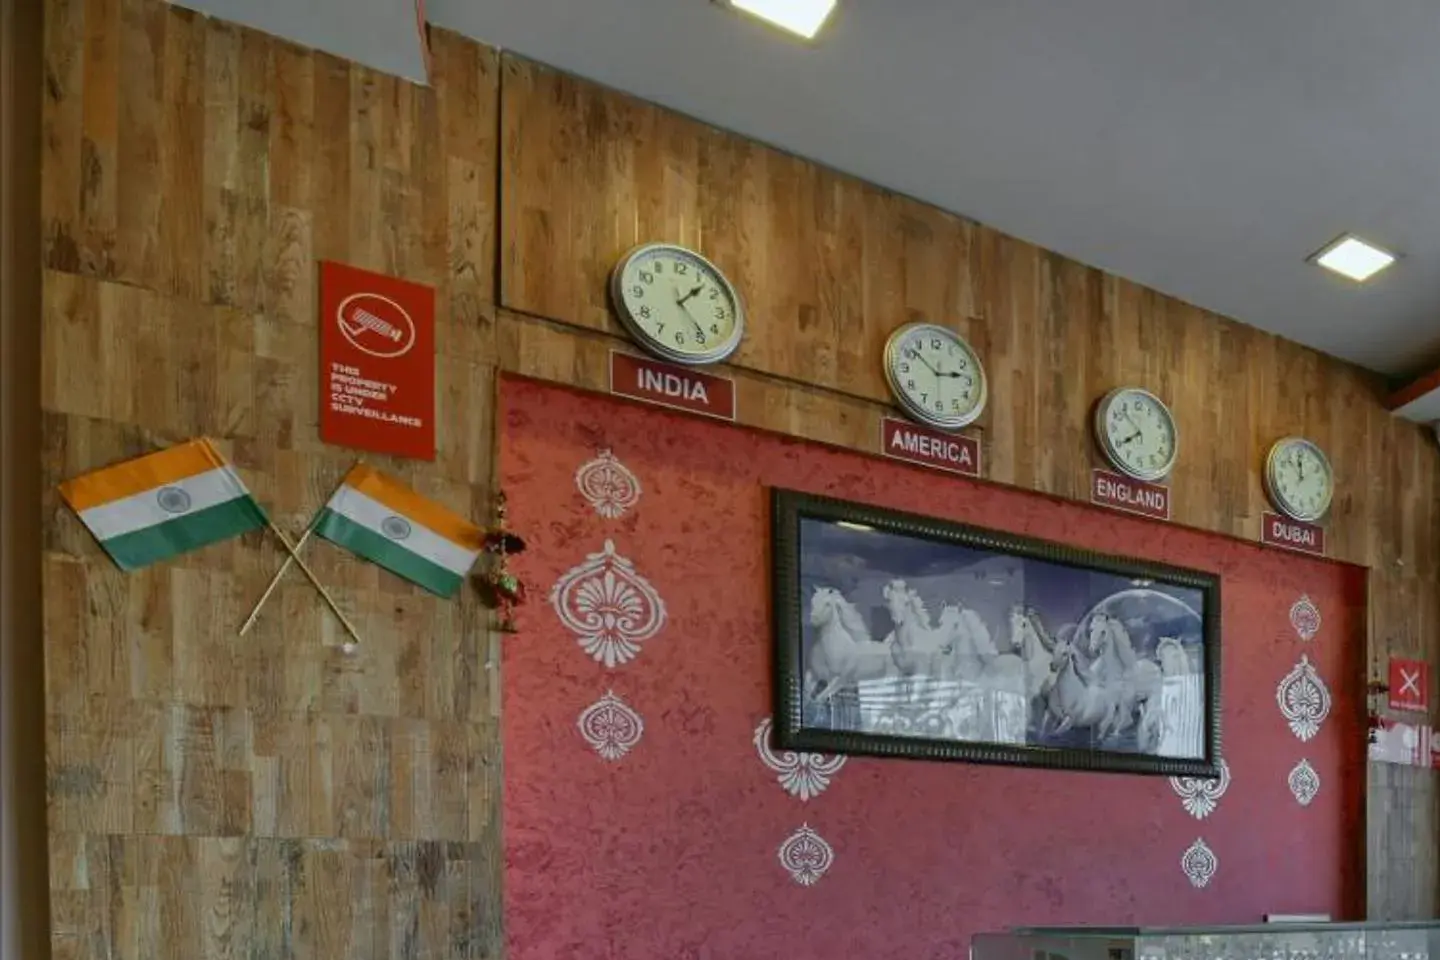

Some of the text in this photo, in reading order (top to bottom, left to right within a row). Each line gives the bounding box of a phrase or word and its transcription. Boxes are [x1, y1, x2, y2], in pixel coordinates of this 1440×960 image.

[674, 262, 688, 275] 12
[633, 286, 644, 299] 9
[709, 287, 720, 300] 2
[640, 305, 651, 319] 8
[715, 307, 725, 320] 3
[656, 322, 665, 335] 7
[710, 323, 719, 335] 4
[675, 331, 685, 345] 6
[930, 339, 942, 351] 12
[331, 372, 398, 394] PROPERTY
[637, 367, 710, 404] INDIA
[331, 392, 364, 406] CCTV
[891, 430, 972, 466] AMERICA
[1097, 479, 1164, 510] ENGLAND
[1272, 521, 1315, 546] DUBAI
